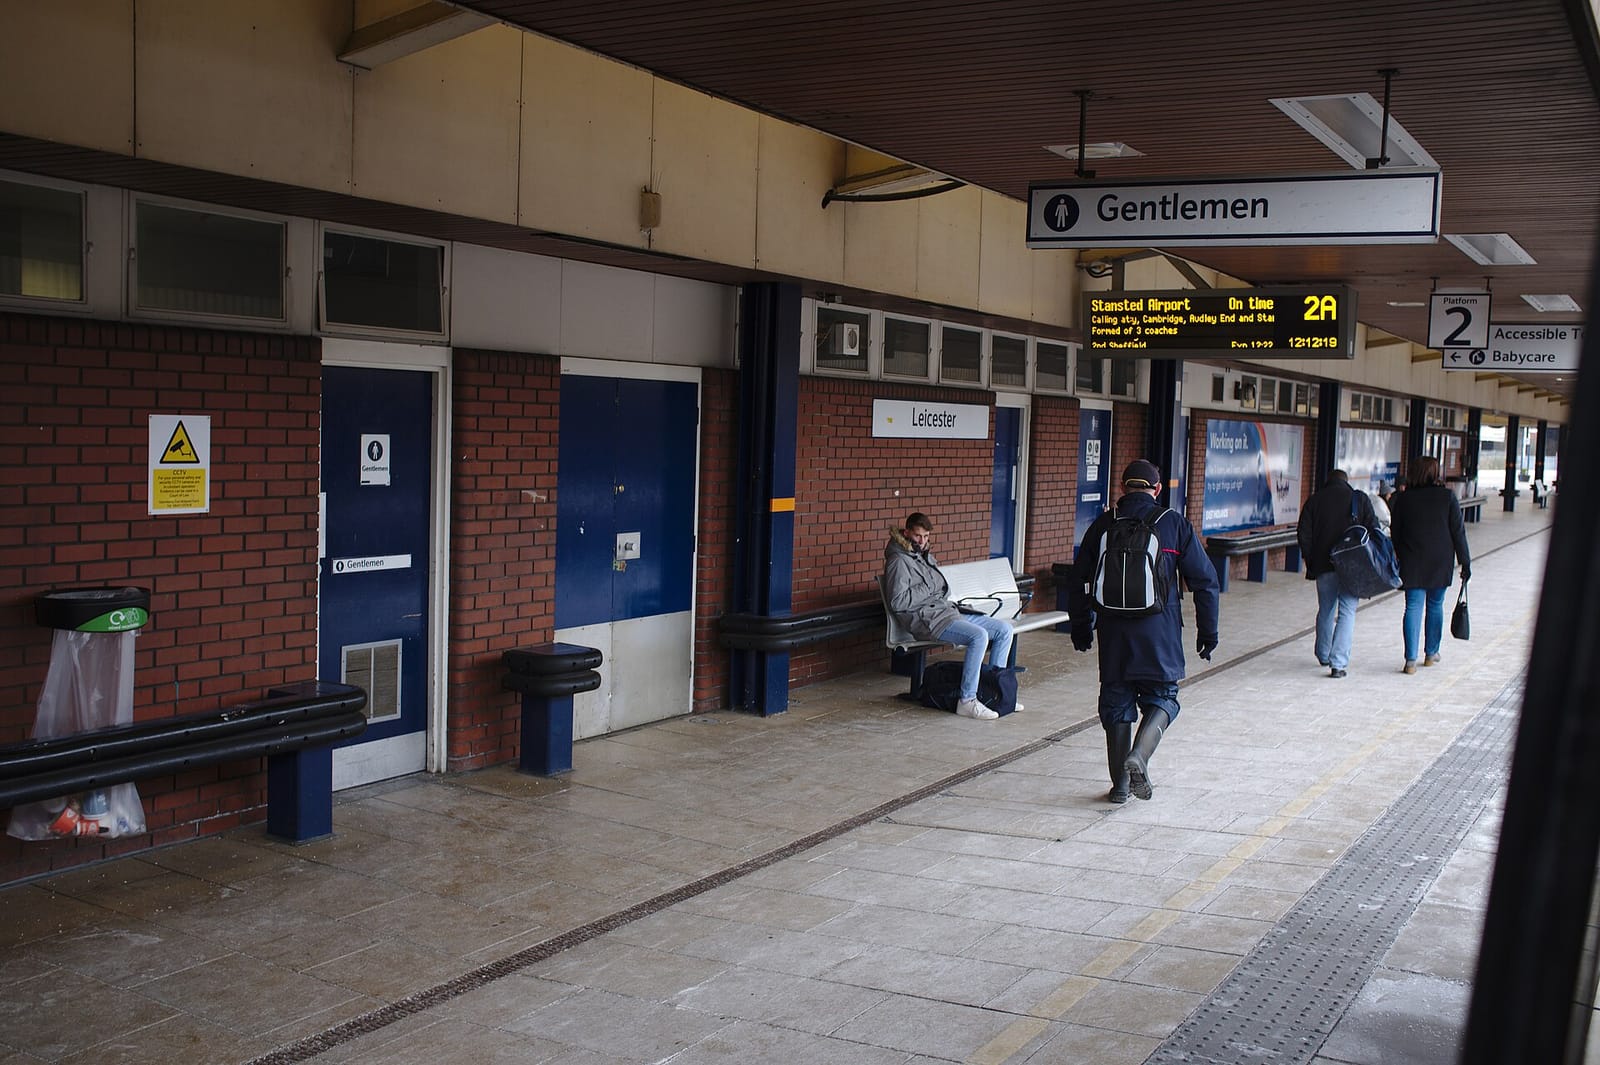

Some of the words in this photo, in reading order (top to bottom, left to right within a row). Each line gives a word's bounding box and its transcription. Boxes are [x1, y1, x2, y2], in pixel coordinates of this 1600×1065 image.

[1097, 193, 1268, 223] Gentlemen
[1091, 299, 1143, 312] Stansted
[1148, 298, 1191, 312] Airport
[1228, 297, 1243, 310] On
[1248, 296, 1274, 310] time
[1304, 295, 1337, 321] 2A
[1443, 297, 1477, 305] Platform
[1091, 315, 1118, 325] Calling
[1142, 314, 1187, 325] Cambridge,
[1189, 314, 1217, 325] Audley
[1220, 314, 1236, 323] End
[1239, 314, 1255, 323] and
[1443, 306, 1472, 346] 2
[1091, 326, 1120, 335] Formed
[1123, 326, 1133, 335] of
[1136, 326, 1142, 335] 3
[1144, 326, 1178, 335] coaches
[1494, 327, 1567, 340] Accessible
[1289, 337, 1337, 348] 12:12:19
[1492, 350, 1556, 365] Babycare
[912, 407, 957, 428] Leicester
[1210, 432, 1234, 453] Working
[1234, 437, 1242, 450] on
[362, 464, 388, 472] Gentlemen
[346, 559, 385, 569] Gentlemen
